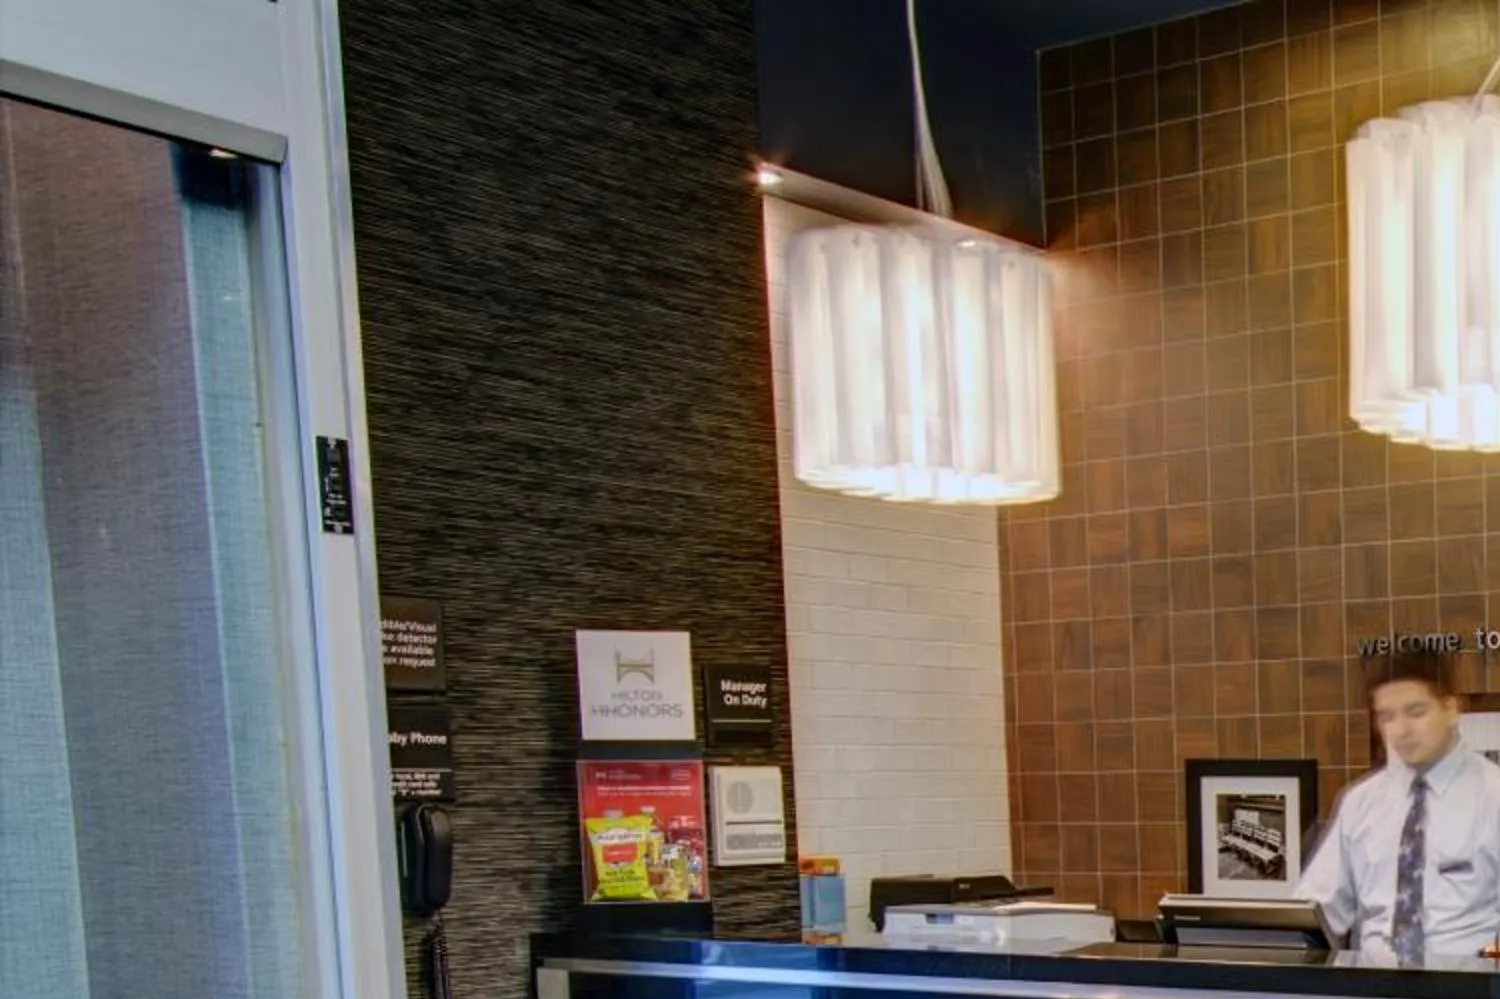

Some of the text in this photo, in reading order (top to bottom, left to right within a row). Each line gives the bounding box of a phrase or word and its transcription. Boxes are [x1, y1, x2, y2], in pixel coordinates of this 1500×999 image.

[1356, 629, 1460, 656] welcome
[720, 679, 767, 695] Manager
[611, 689, 663, 702] HILTON
[723, 693, 767, 709] On Duty
[590, 703, 683, 719] HHONORS
[410, 731, 447, 745] Phone
